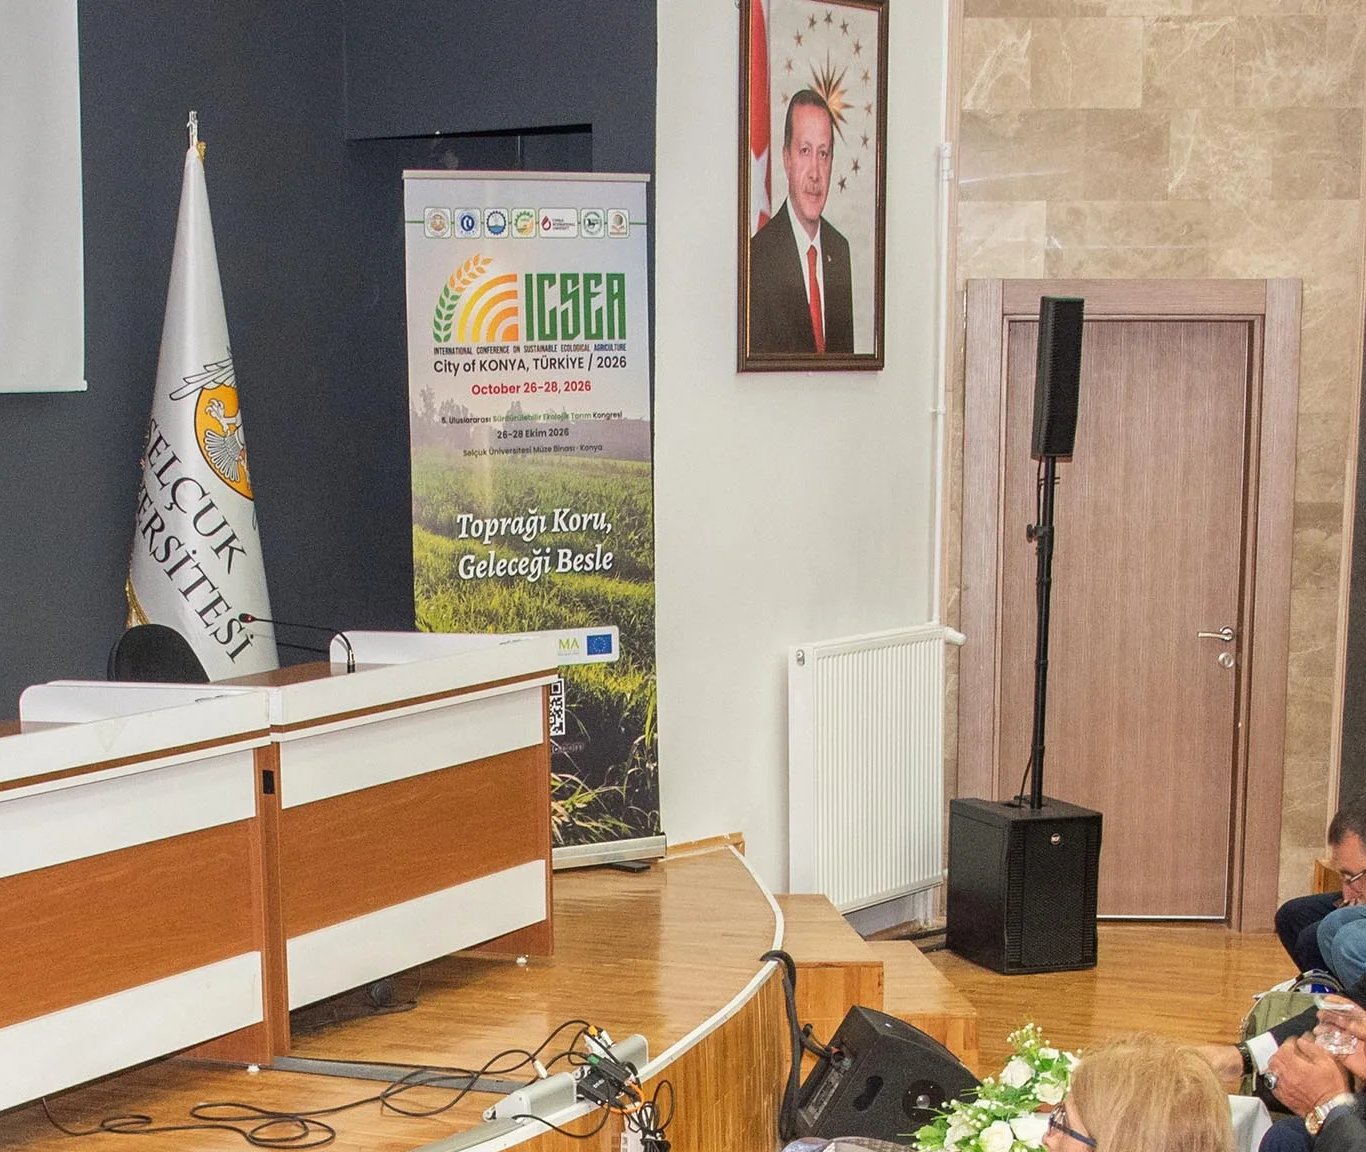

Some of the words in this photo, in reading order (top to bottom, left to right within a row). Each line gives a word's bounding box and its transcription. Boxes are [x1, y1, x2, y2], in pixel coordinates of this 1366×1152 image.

[524, 272, 627, 342] ICSEA
[433, 347, 473, 355] INTERNATIONAL
[476, 346, 509, 354] CONFERENCE
[524, 344, 557, 353] SUSTAINABLE
[560, 344, 590, 353] ECOLOGICAL
[594, 343, 627, 352] AGRICULTURE
[434, 359, 460, 377] City
[463, 359, 475, 373] of
[480, 358, 530, 372] KONYA,
[534, 354, 584, 370] TÜRKİYE
[597, 355, 627, 369] 2026
[471, 382, 521, 396] October
[564, 380, 592, 392] 2026
[593, 410, 623, 421] Kongresi
[525, 428, 547, 438] Ekim
[549, 427, 569, 437] 2026
[456, 508, 547, 545] Toprağı
[551, 507, 613, 535] Koru,
[458, 548, 552, 583] Geleceği
[556, 544, 614, 574] Besle
